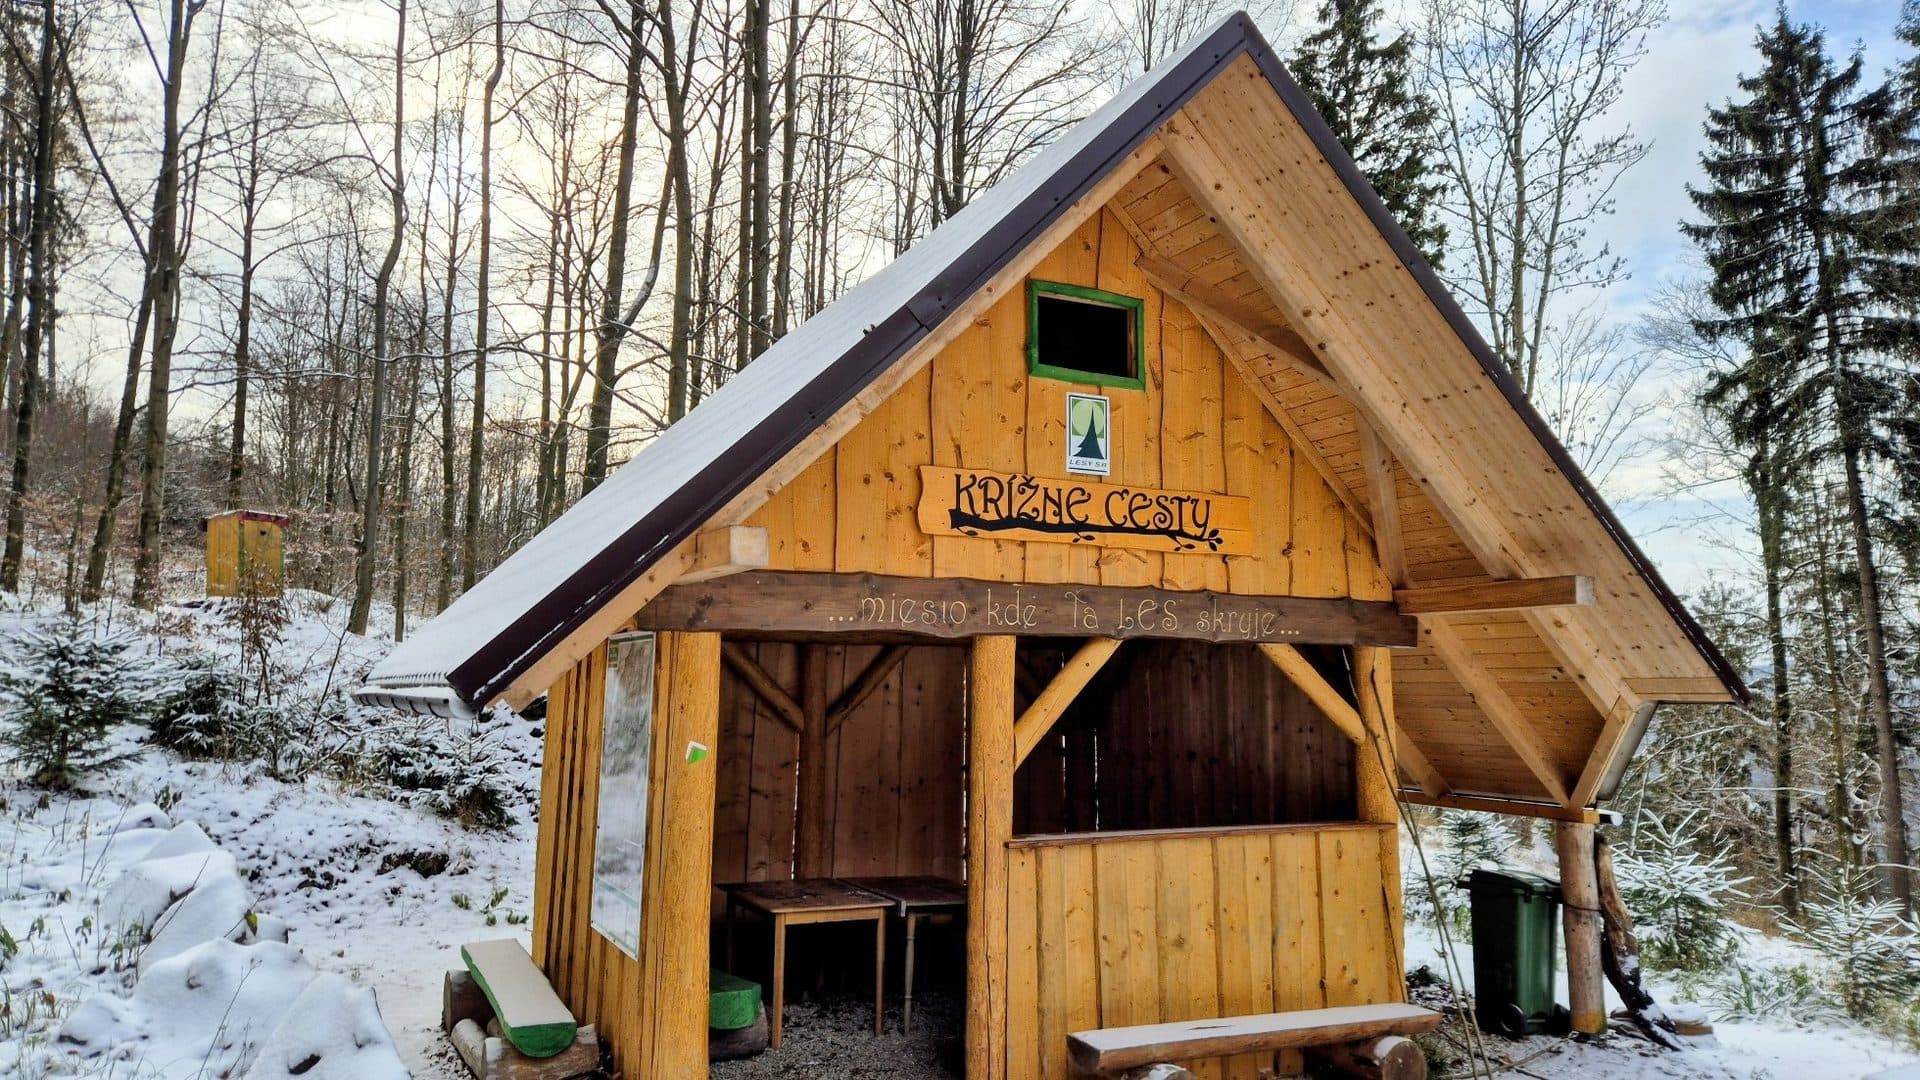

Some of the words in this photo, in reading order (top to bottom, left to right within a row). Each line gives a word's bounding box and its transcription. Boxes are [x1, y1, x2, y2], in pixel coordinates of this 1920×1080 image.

[1069, 459, 1092, 468] LESY
[954, 473, 1092, 525] KRÍŽNE
[1105, 488, 1211, 537] CESTY
[986, 588, 1038, 628] kde
